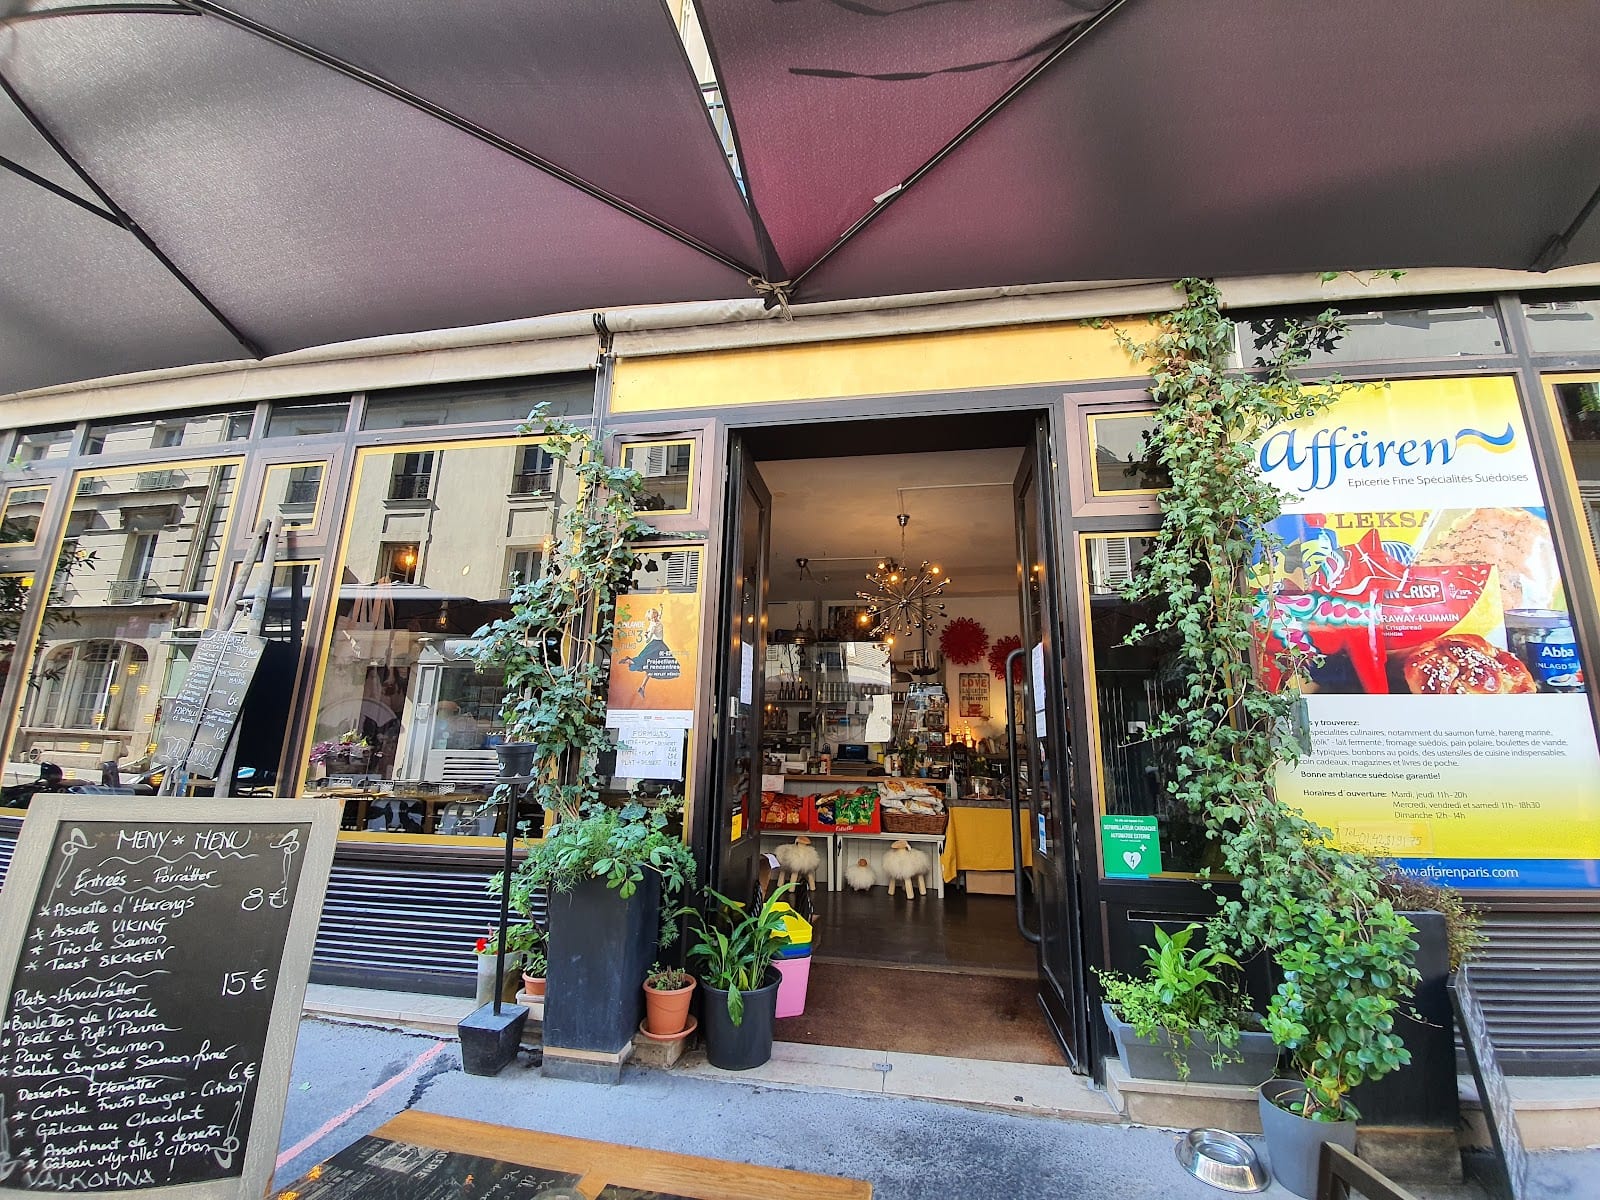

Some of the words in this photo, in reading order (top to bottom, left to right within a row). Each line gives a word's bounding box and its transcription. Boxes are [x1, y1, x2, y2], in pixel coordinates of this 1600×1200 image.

[1347, 477, 1390, 489] Epicerie
[1392, 476, 1415, 486] Fine
[1416, 473, 1474, 486] Spécialités
[1475, 472, 1529, 483] Suédoises
[1541, 646, 1575, 658] Abba
[962, 679, 987, 687] LOVE
[1387, 728, 1431, 737] notamment
[1433, 729, 1443, 737] du
[1498, 729, 1524, 738] hareng
[1386, 739, 1417, 748] fromage
[1450, 739, 1467, 748] pain
[1495, 739, 1529, 747] boulettes
[1351, 748, 1385, 756] bonbons
[1422, 749, 1435, 757] des
[1436, 749, 1472, 757] ustensiles
[1473, 749, 1484, 757] de
[1484, 749, 1510, 757] cuisine
[1300, 758, 1315, 766] coin
[1351, 759, 1391, 768] magazines
[1401, 758, 1421, 767] livres
[1422, 759, 1432, 767] de
[1300, 770, 1327, 778] Bonne
[1327, 770, 1367, 779] ambiance
[1368, 770, 1405, 779] suédoise
[1303, 788, 1337, 797] Horaires
[1416, 791, 1434, 799] jeudi
[1429, 801, 1461, 809] vendredi
[1471, 801, 1499, 809] samedi
[1394, 811, 1433, 819] Dimanche
[116, 829, 173, 857] MENY
[194, 829, 252, 851] MENU
[53, 900, 109, 917] Assiette
[50, 919, 100, 938] Assiette
[111, 916, 169, 934] VIKING
[49, 939, 82, 956] Trio
[84, 937, 104, 952] de
[109, 933, 168, 950] Saumon
[44, 956, 91, 971] Toast
[98, 945, 176, 968] SKAGEN
[14, 989, 48, 1007] Plats
[11, 1012, 75, 1031] Boulettes
[79, 1009, 104, 1024] de
[107, 1002, 158, 1022] Viande
[58, 1029, 78, 1041] de
[11, 1063, 61, 1077] Salade
[135, 1054, 191, 1070] Saumon
[192, 1039, 238, 1070] fumé
[15, 1047, 59, 1062] Pavé
[62, 1044, 85, 1060] de
[93, 1040, 165, 1058] Saumon
[31, 1101, 92, 1120] Crumble
[200, 1079, 244, 1097] Citron
[36, 1121, 95, 1143] Gâteau
[97, 1122, 119, 1131] au
[126, 1104, 205, 1127] Chocolat
[128, 1131, 149, 1148] de
[154, 1131, 165, 1147] 3
